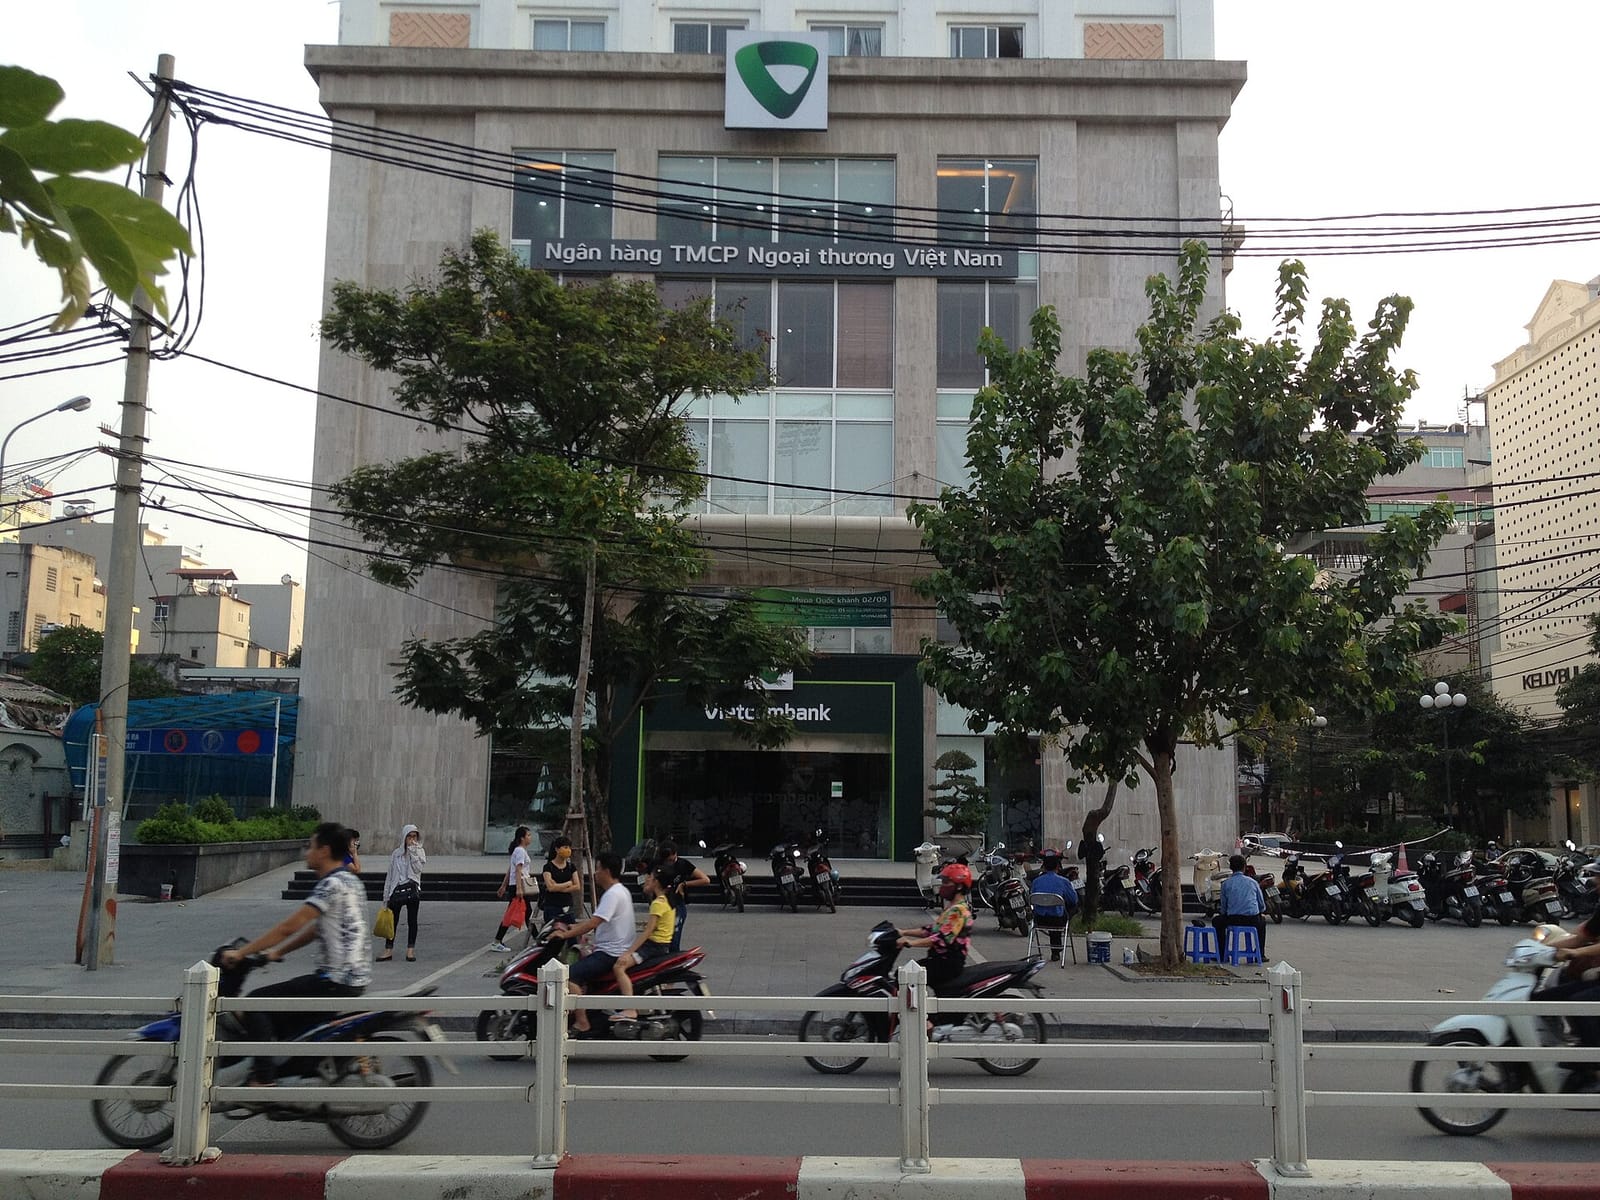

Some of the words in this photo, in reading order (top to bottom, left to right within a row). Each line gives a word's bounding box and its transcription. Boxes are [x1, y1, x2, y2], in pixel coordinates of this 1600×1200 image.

[545, 242, 602, 264] Ngân
[610, 244, 662, 266] hàng
[670, 245, 739, 264] TMCP
[748, 246, 810, 269] Ngoại
[818, 248, 895, 269] thương
[903, 247, 948, 269] Việt
[954, 248, 1003, 267] Nam
[704, 703, 832, 721] Vietcmbank
